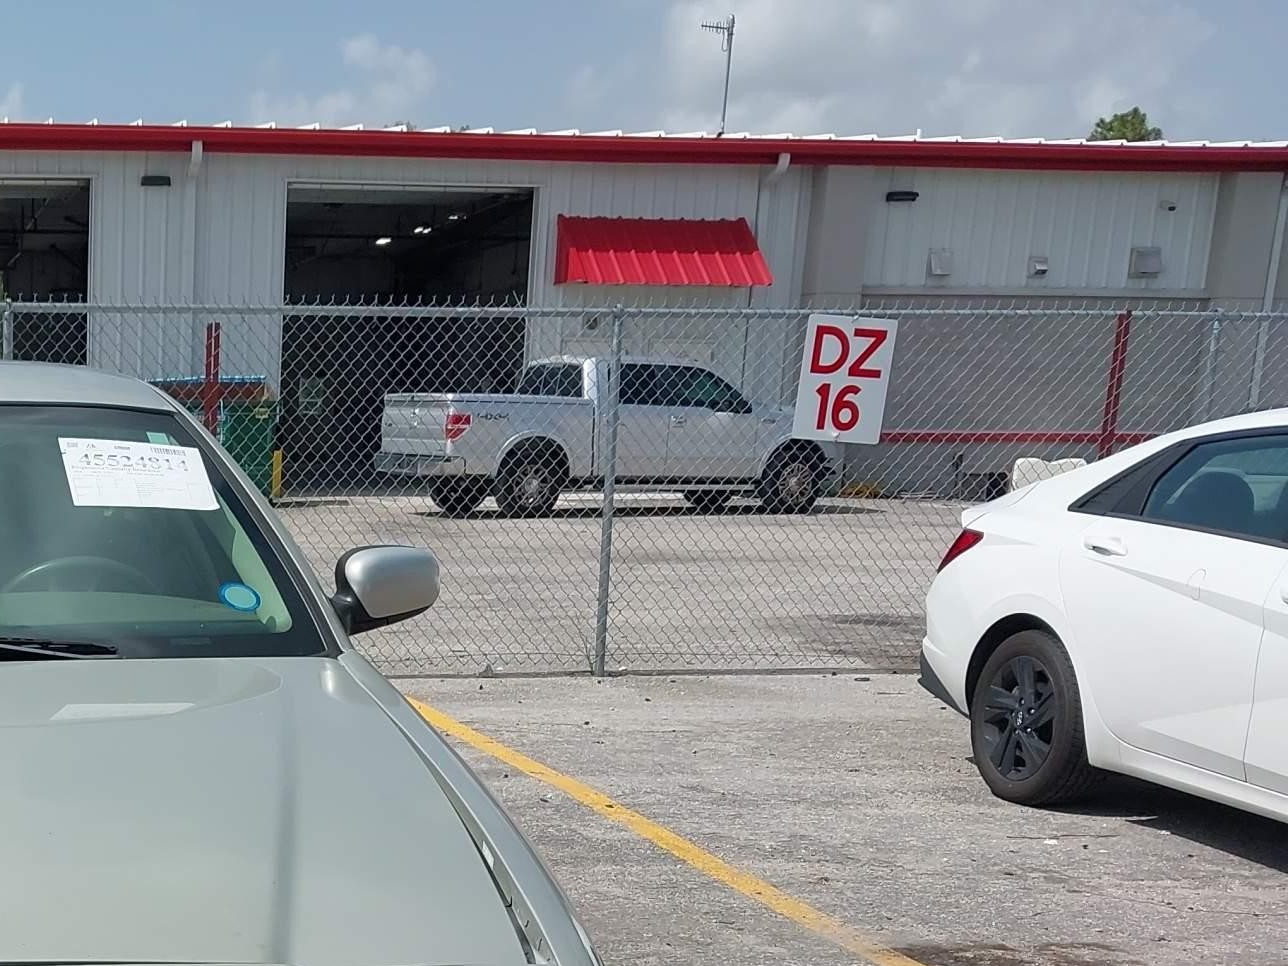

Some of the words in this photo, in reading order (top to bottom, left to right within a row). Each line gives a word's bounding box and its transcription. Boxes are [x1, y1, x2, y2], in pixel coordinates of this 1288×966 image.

[810, 325, 888, 379] DZ
[815, 383, 862, 432] 16
[79, 453, 189, 472] 45524814
